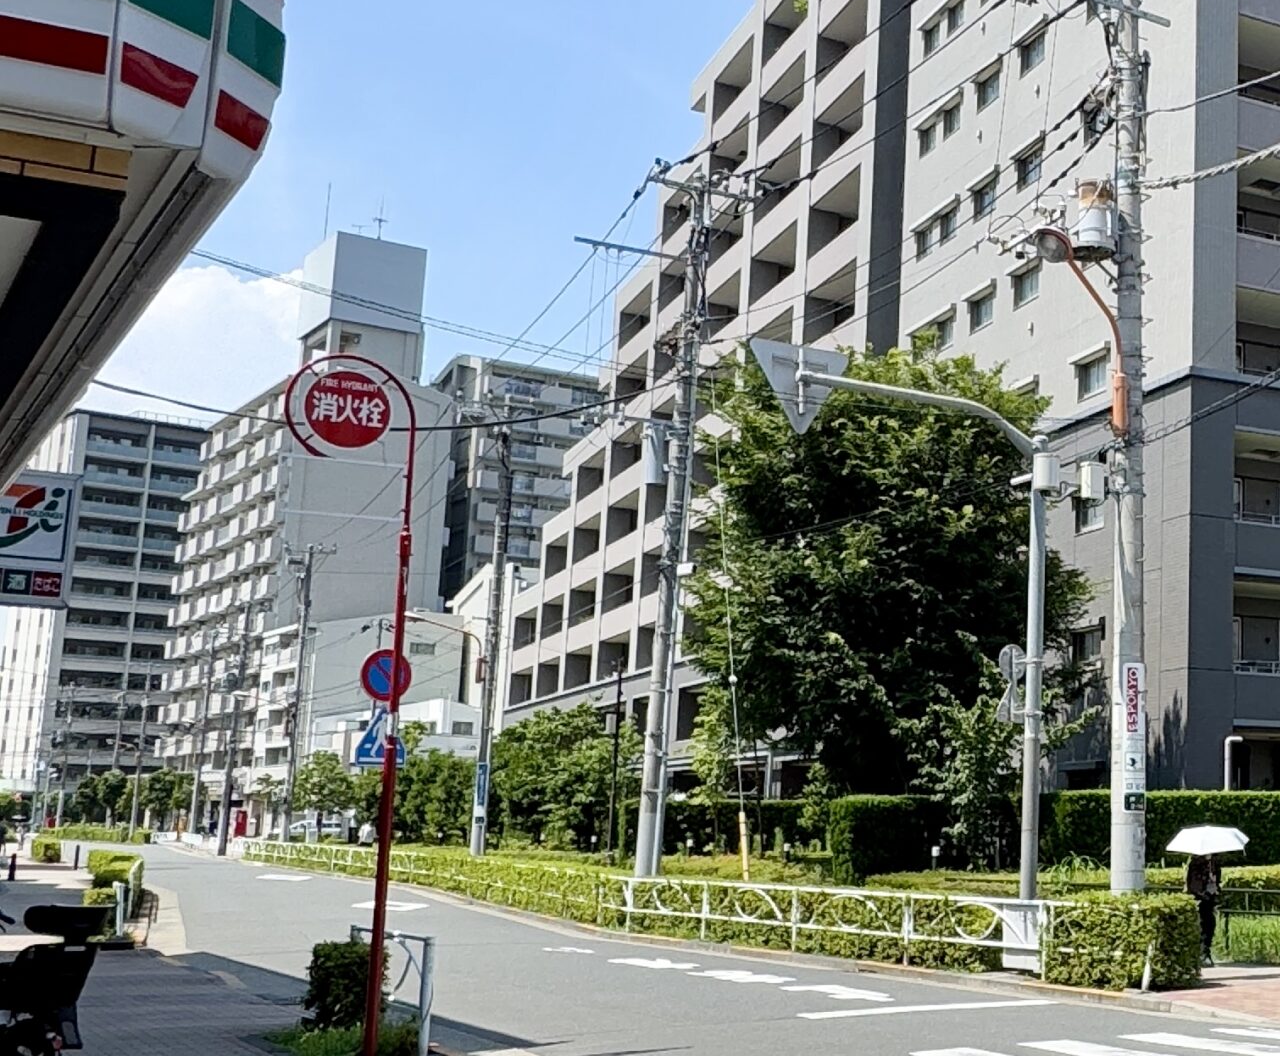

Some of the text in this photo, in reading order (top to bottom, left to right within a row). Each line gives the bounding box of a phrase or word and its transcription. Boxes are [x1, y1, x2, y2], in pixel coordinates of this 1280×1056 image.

[320, 378, 378, 392] FIRE HYDRANT
[312, 391, 386, 428] 消火栓
[7, 574, 27, 591] 酒
[34, 577, 60, 592] たばこ
